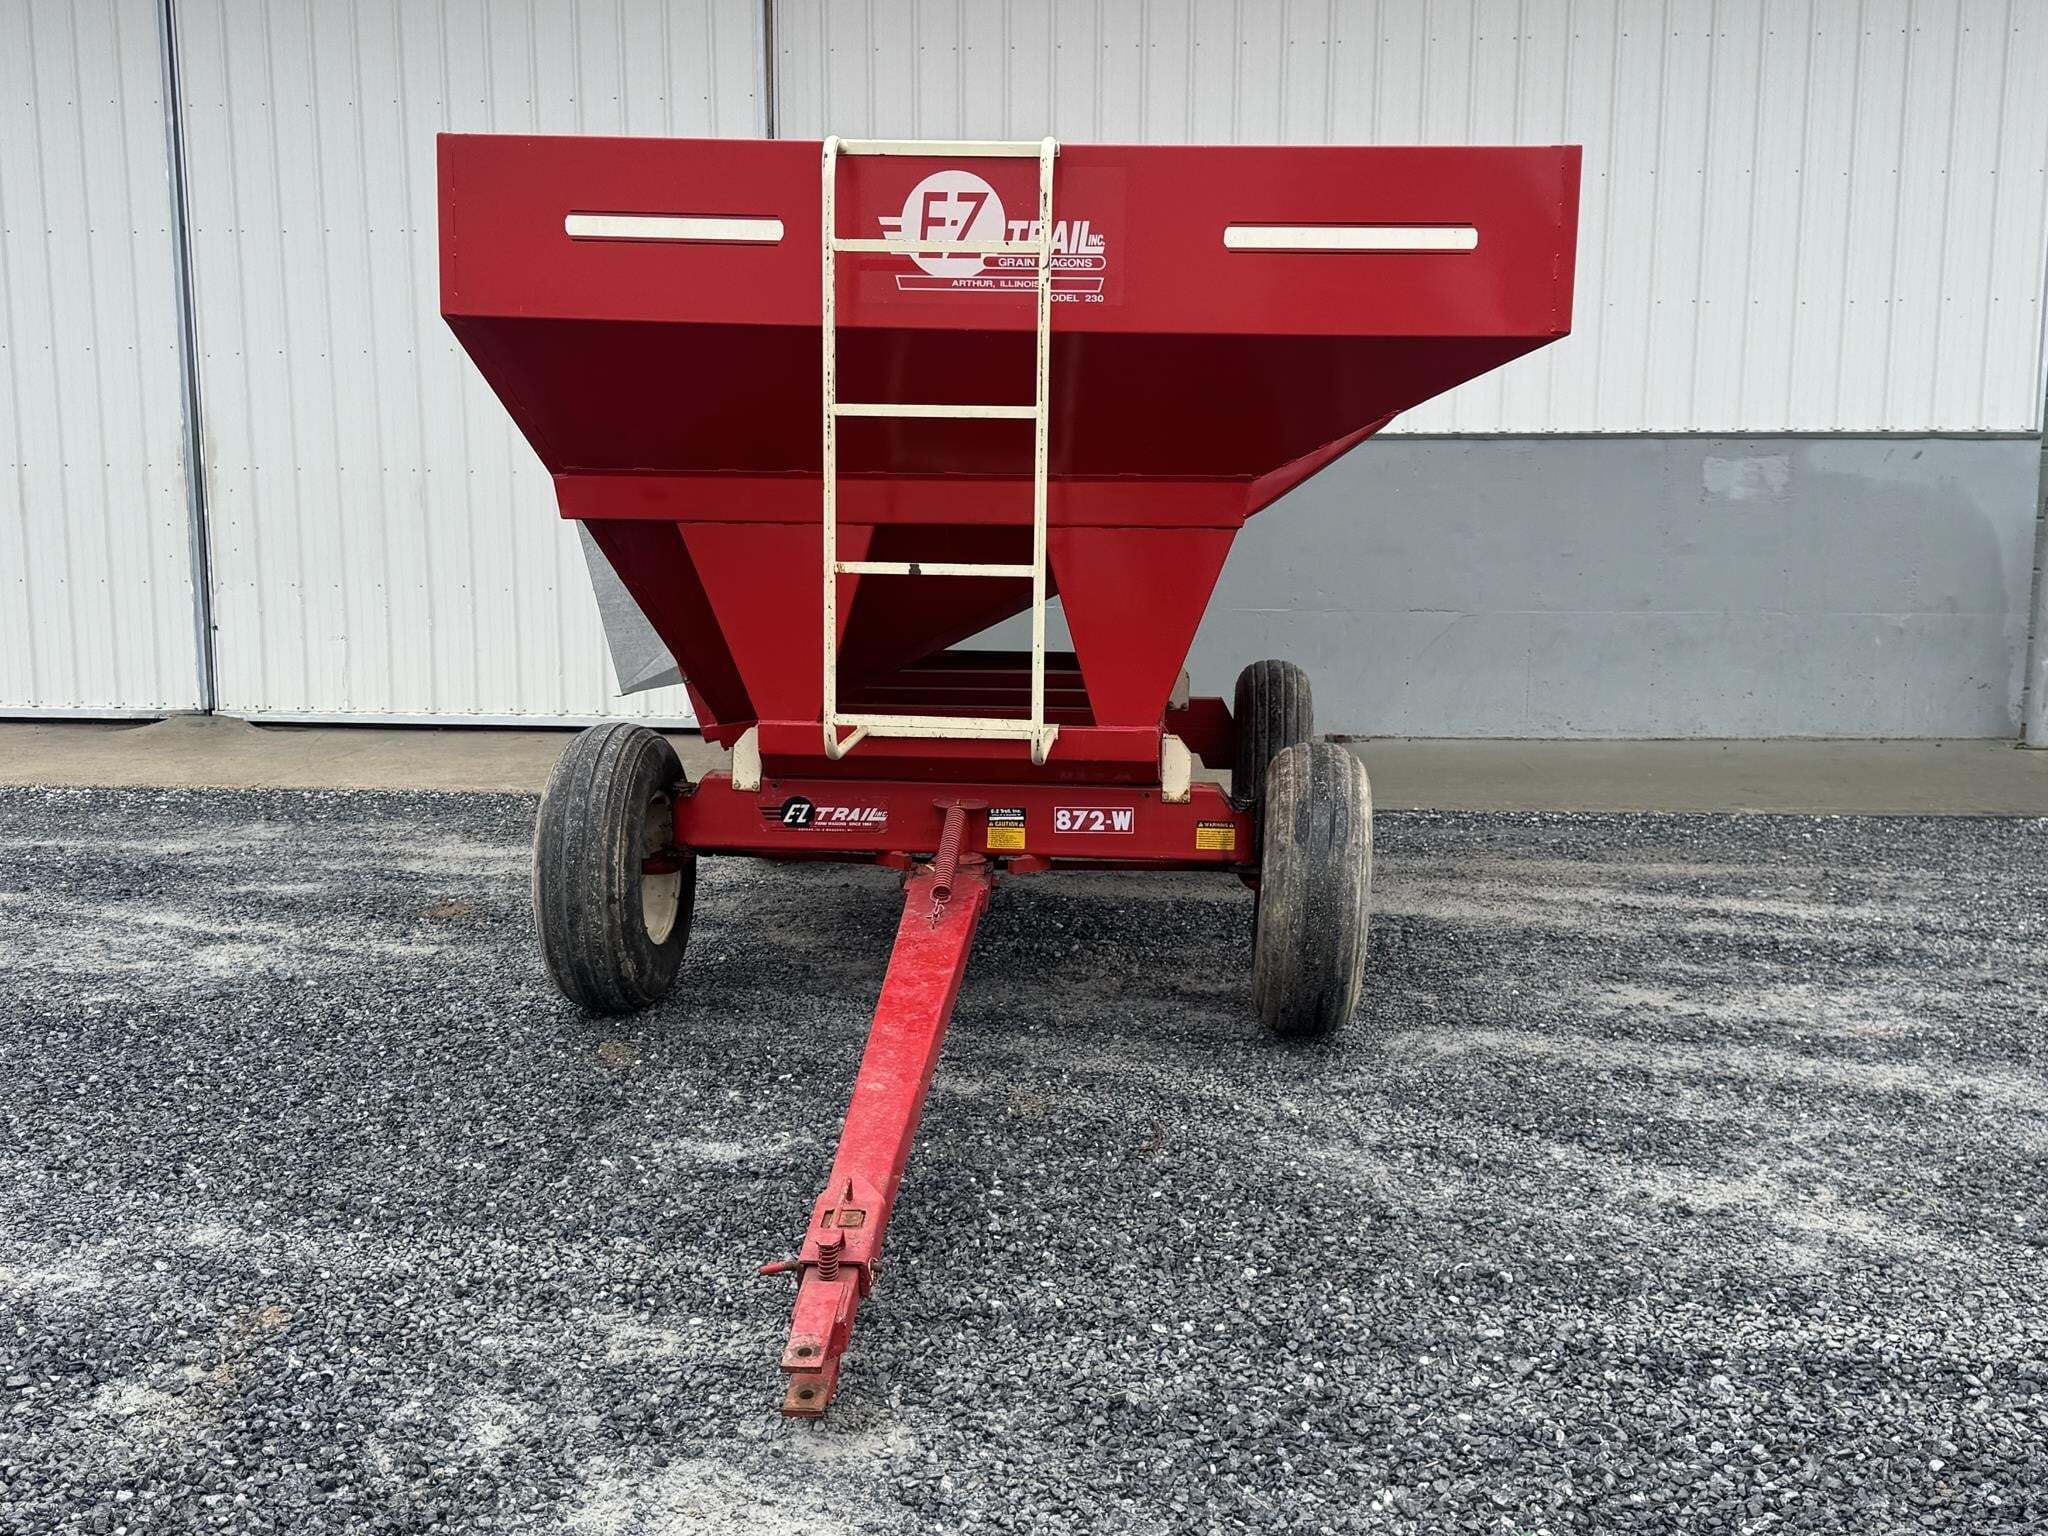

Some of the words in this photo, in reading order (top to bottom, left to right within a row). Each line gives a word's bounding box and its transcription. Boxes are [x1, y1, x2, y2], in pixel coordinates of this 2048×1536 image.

[1088, 234, 1105, 246] INC.
[998, 257, 1035, 268] GRAIN
[1049, 257, 1093, 268] AGONS
[951, 279, 996, 289] ARTHUR,
[1050, 294, 1080, 303] ODEL
[1085, 294, 1104, 303] 230
[815, 807, 888, 821] TRAIL
[1056, 809, 1132, 831] 872-W
